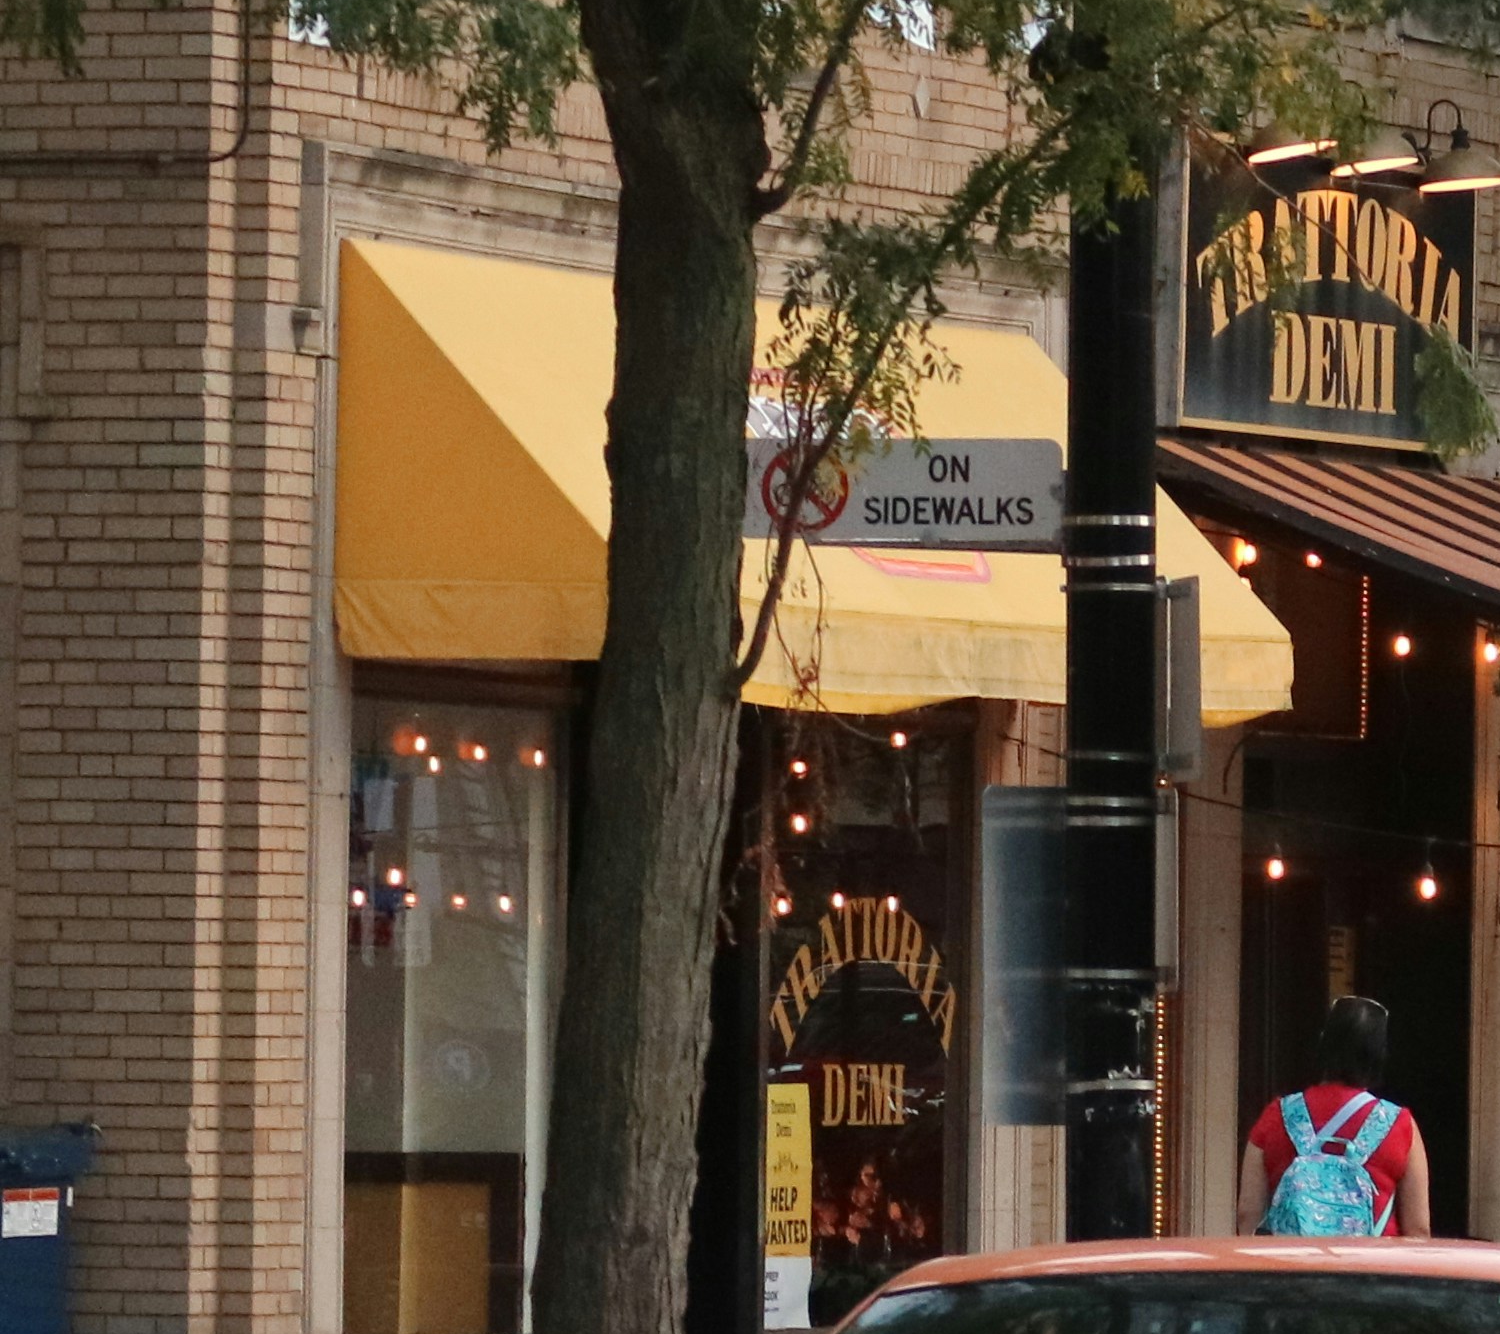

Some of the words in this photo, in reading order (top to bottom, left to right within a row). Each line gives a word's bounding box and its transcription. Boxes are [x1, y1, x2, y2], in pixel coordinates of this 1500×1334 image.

[1196, 189, 1461, 344] TRATTORIA
[1269, 310, 1397, 415] DEMI
[928, 454, 970, 483] ON
[863, 496, 1034, 526] SIDEWALKS
[770, 896, 956, 1058] TRATTORIA
[821, 1064, 905, 1127] DEMI
[770, 1186, 798, 1212] HELP
